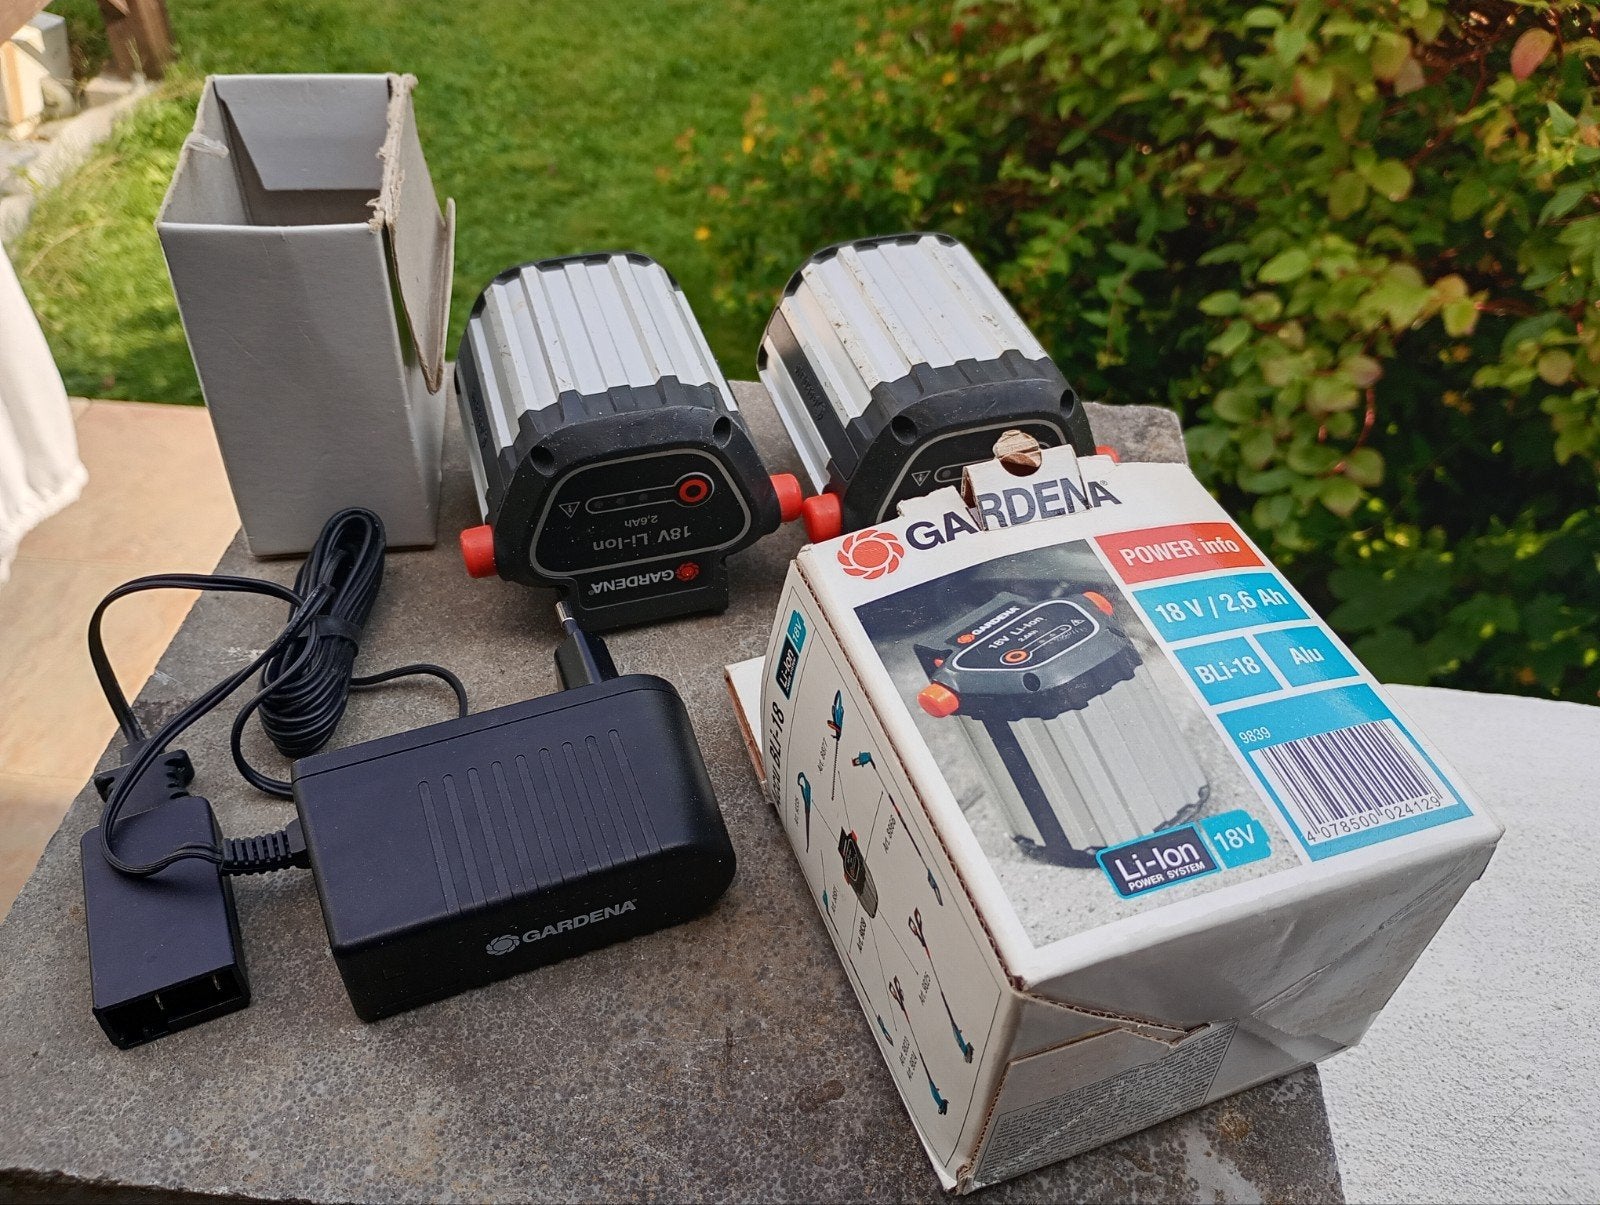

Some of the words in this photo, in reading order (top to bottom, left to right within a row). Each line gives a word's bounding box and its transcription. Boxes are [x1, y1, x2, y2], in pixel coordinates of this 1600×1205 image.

[624, 514, 658, 528] 2,6Ah
[905, 477, 1122, 550] GARDENA
[592, 532, 649, 551] Li-Ion
[657, 526, 692, 543] 18V
[1118, 539, 1200, 567] POWER
[1196, 536, 1241, 555] info
[590, 569, 675, 594] GARDENA
[1154, 602, 1187, 624] 18
[1182, 598, 1205, 618] V
[1218, 590, 1257, 613] 2,6
[1256, 587, 1290, 607] Ah
[792, 617, 803, 643] 18V
[971, 606, 1019, 636] GARDENA
[988, 635, 1011, 650] 18V
[1292, 645, 1325, 666] Alu
[779, 648, 795, 689] Li-Ion
[1193, 655, 1262, 685] BLi-18
[769, 701, 785, 769] BLi-18
[1239, 726, 1271, 744] 9839
[1213, 823, 1256, 852] 18V
[1114, 842, 1201, 883] Li-Ion
[1127, 872, 1165, 892] POWER
[1167, 860, 1206, 881] SYSTEM
[521, 900, 638, 943] GARDENA
